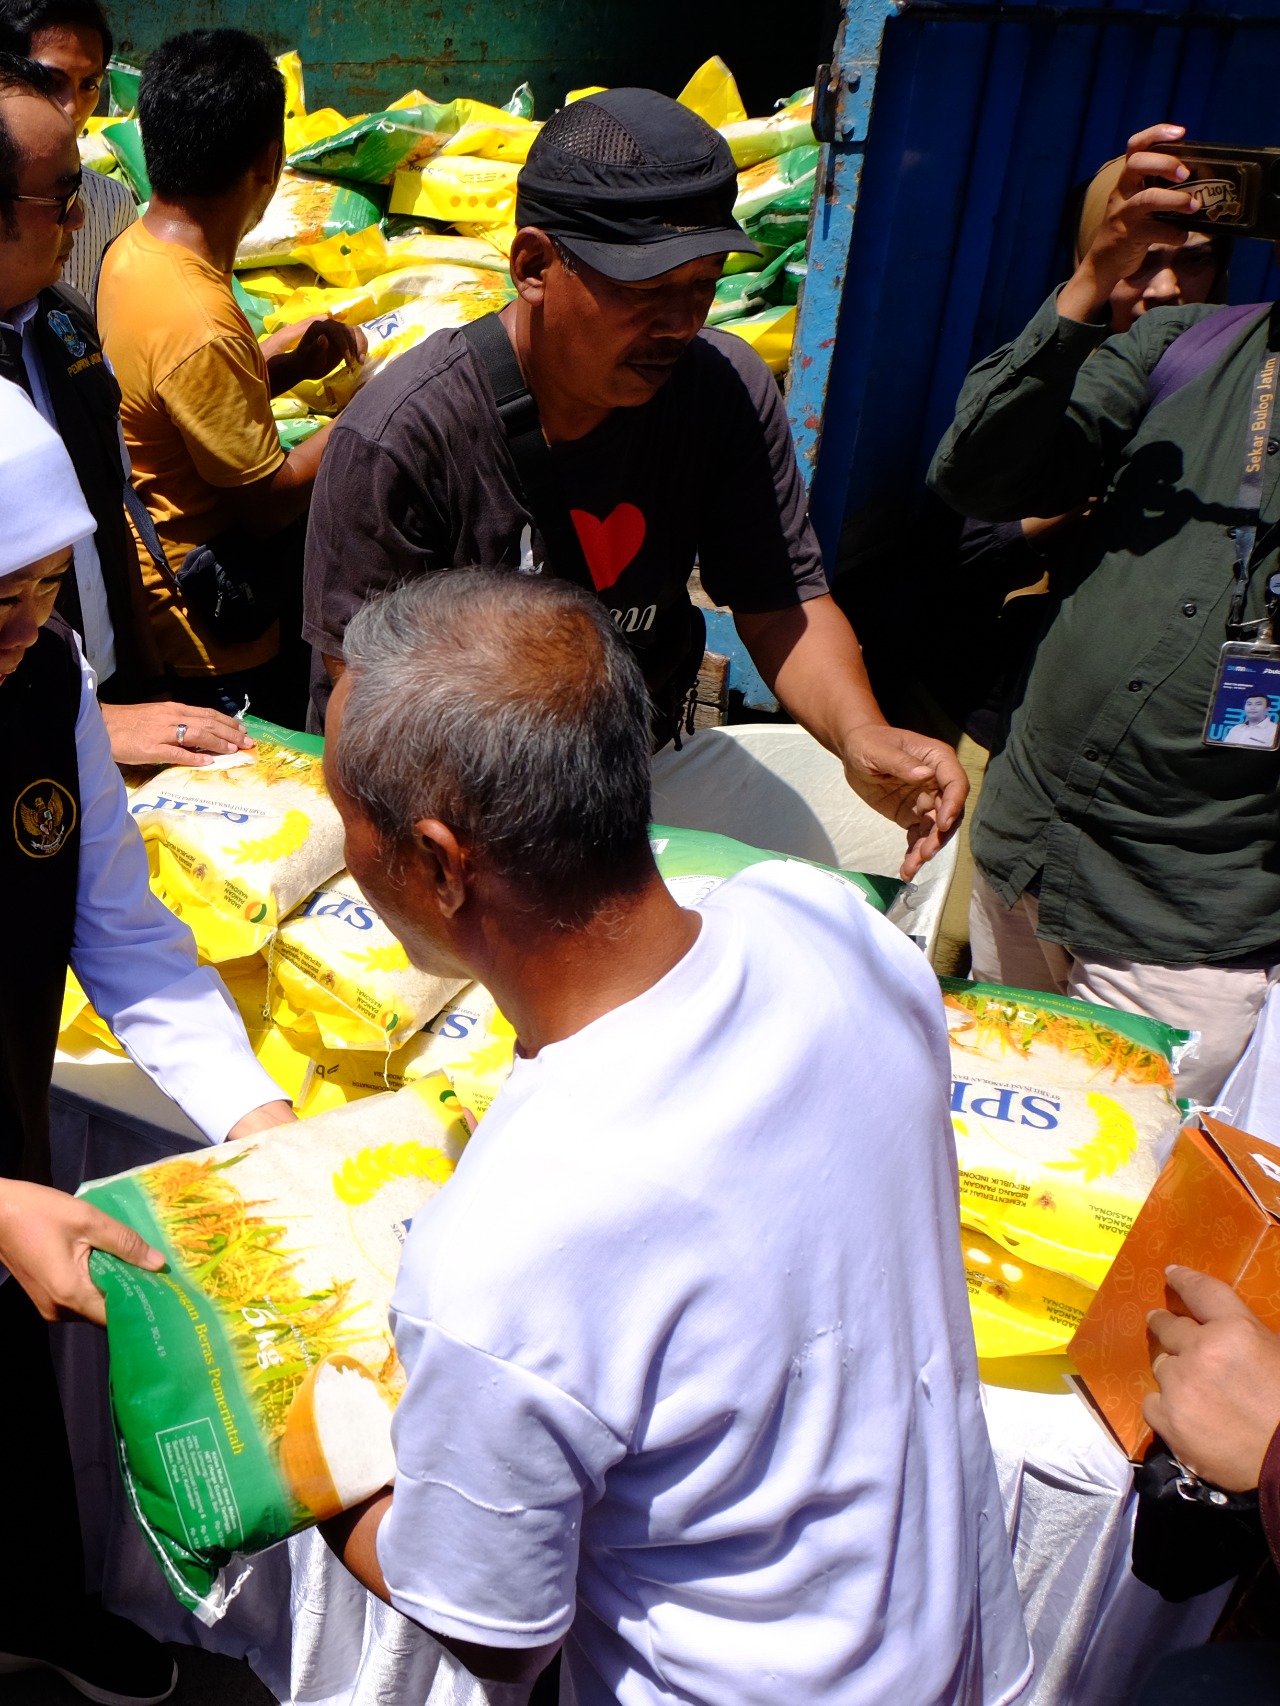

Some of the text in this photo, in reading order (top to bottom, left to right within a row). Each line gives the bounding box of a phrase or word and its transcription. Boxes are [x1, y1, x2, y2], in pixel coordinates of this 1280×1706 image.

[1246, 357, 1277, 473] Sekar Bulog Jatim
[224, 880, 249, 900] NASIONAL
[224, 888, 246, 905] PANGAN
[223, 895, 242, 910] BADAN
[356, 988, 382, 1008] NASIONAL
[356, 996, 380, 1014] PANGAN
[356, 1004, 377, 1020] BADAN
[963, 1180, 1029, 1200] BIDANG PANGAN
[991, 1177, 1031, 1192] REPUBLIK
[1089, 1204, 1134, 1223] NASIONAL
[1094, 1214, 1132, 1230] PANGAN
[1098, 1222, 1130, 1237] BADAN
[1042, 1296, 1085, 1317] NASIONAL
[1046, 1306, 1083, 1323] PANGAN
[133, 1284, 156, 1323] SUBROTO
[150, 1326, 168, 1358] NO.49
[1049, 1315, 1080, 1331] BADAN
[241, 1307, 285, 1371] 5 kg
[194, 1322, 216, 1366] Beras
[208, 1366, 246, 1457] Pemerintah
